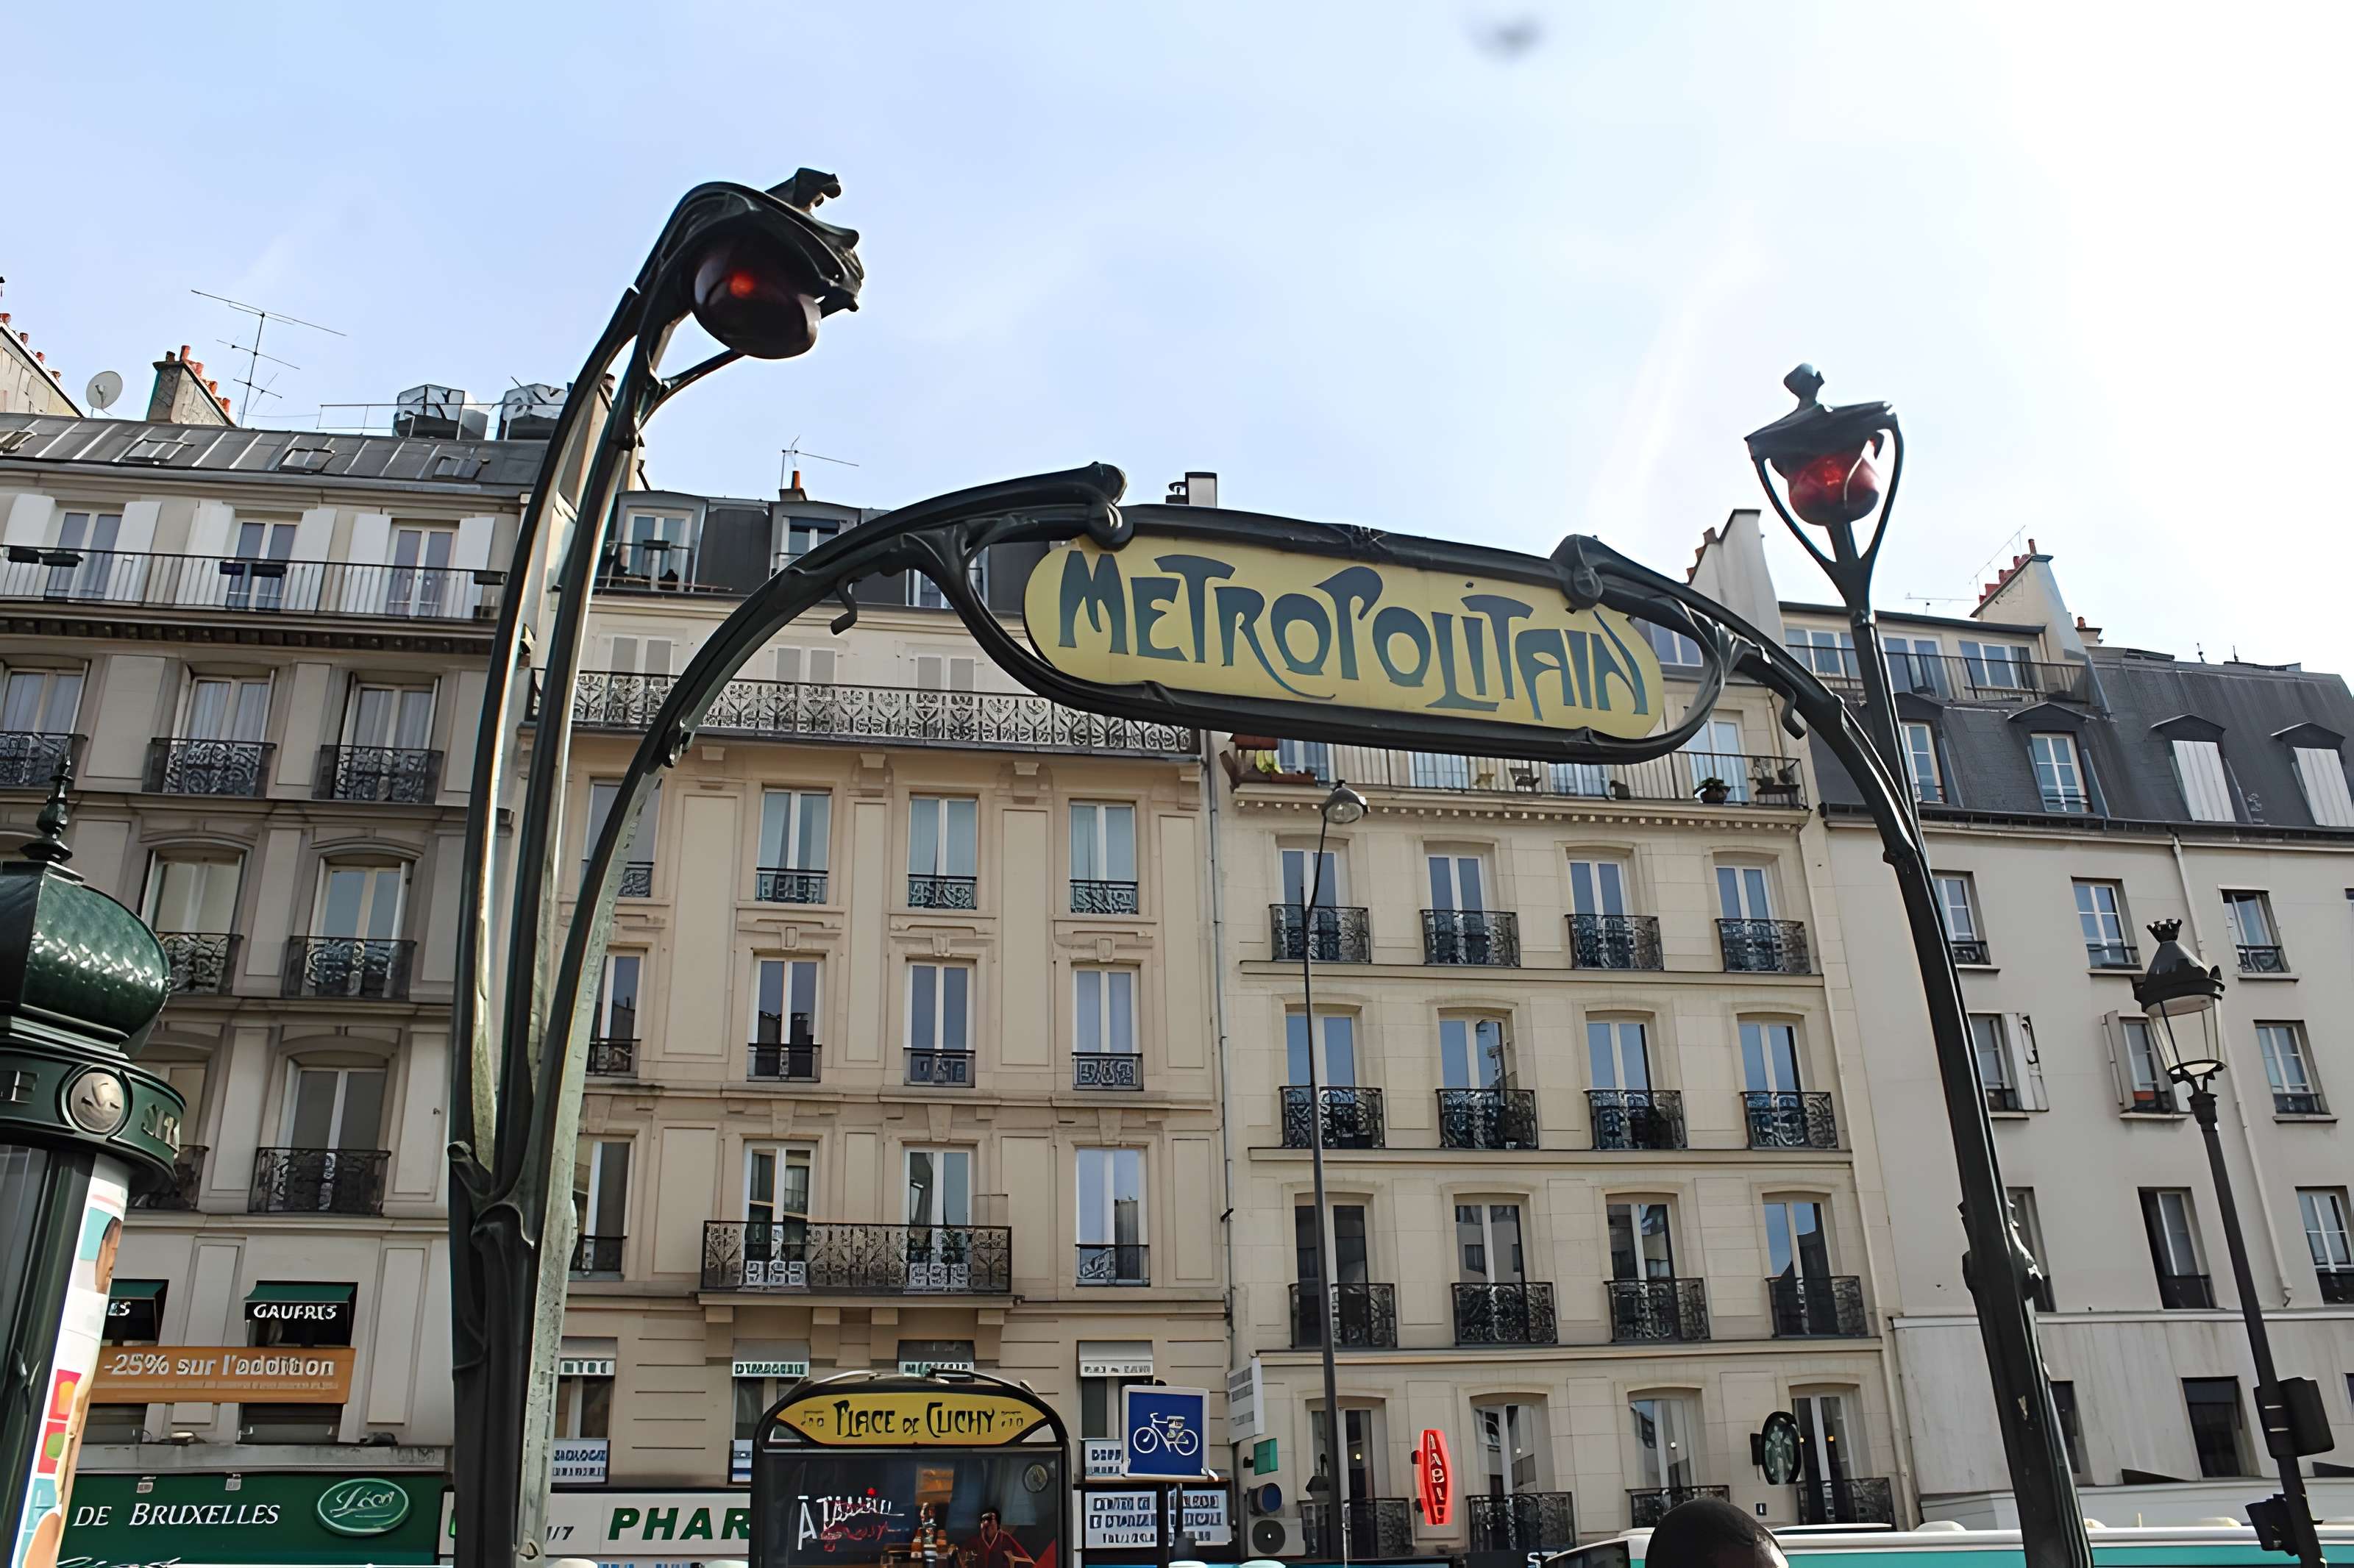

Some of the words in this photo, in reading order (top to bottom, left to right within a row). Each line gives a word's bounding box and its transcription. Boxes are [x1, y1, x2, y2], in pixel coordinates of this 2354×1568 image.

[1058, 547, 1651, 721] METROPOLITAIN
[104, 1353, 169, 1375] -25%
[176, 1358, 216, 1375] sur
[221, 1355, 335, 1377] l'addition
[73, 1505, 112, 1526] DE
[128, 1503, 280, 1526] BRUXELLES
[608, 1508, 750, 1540] PHAR
